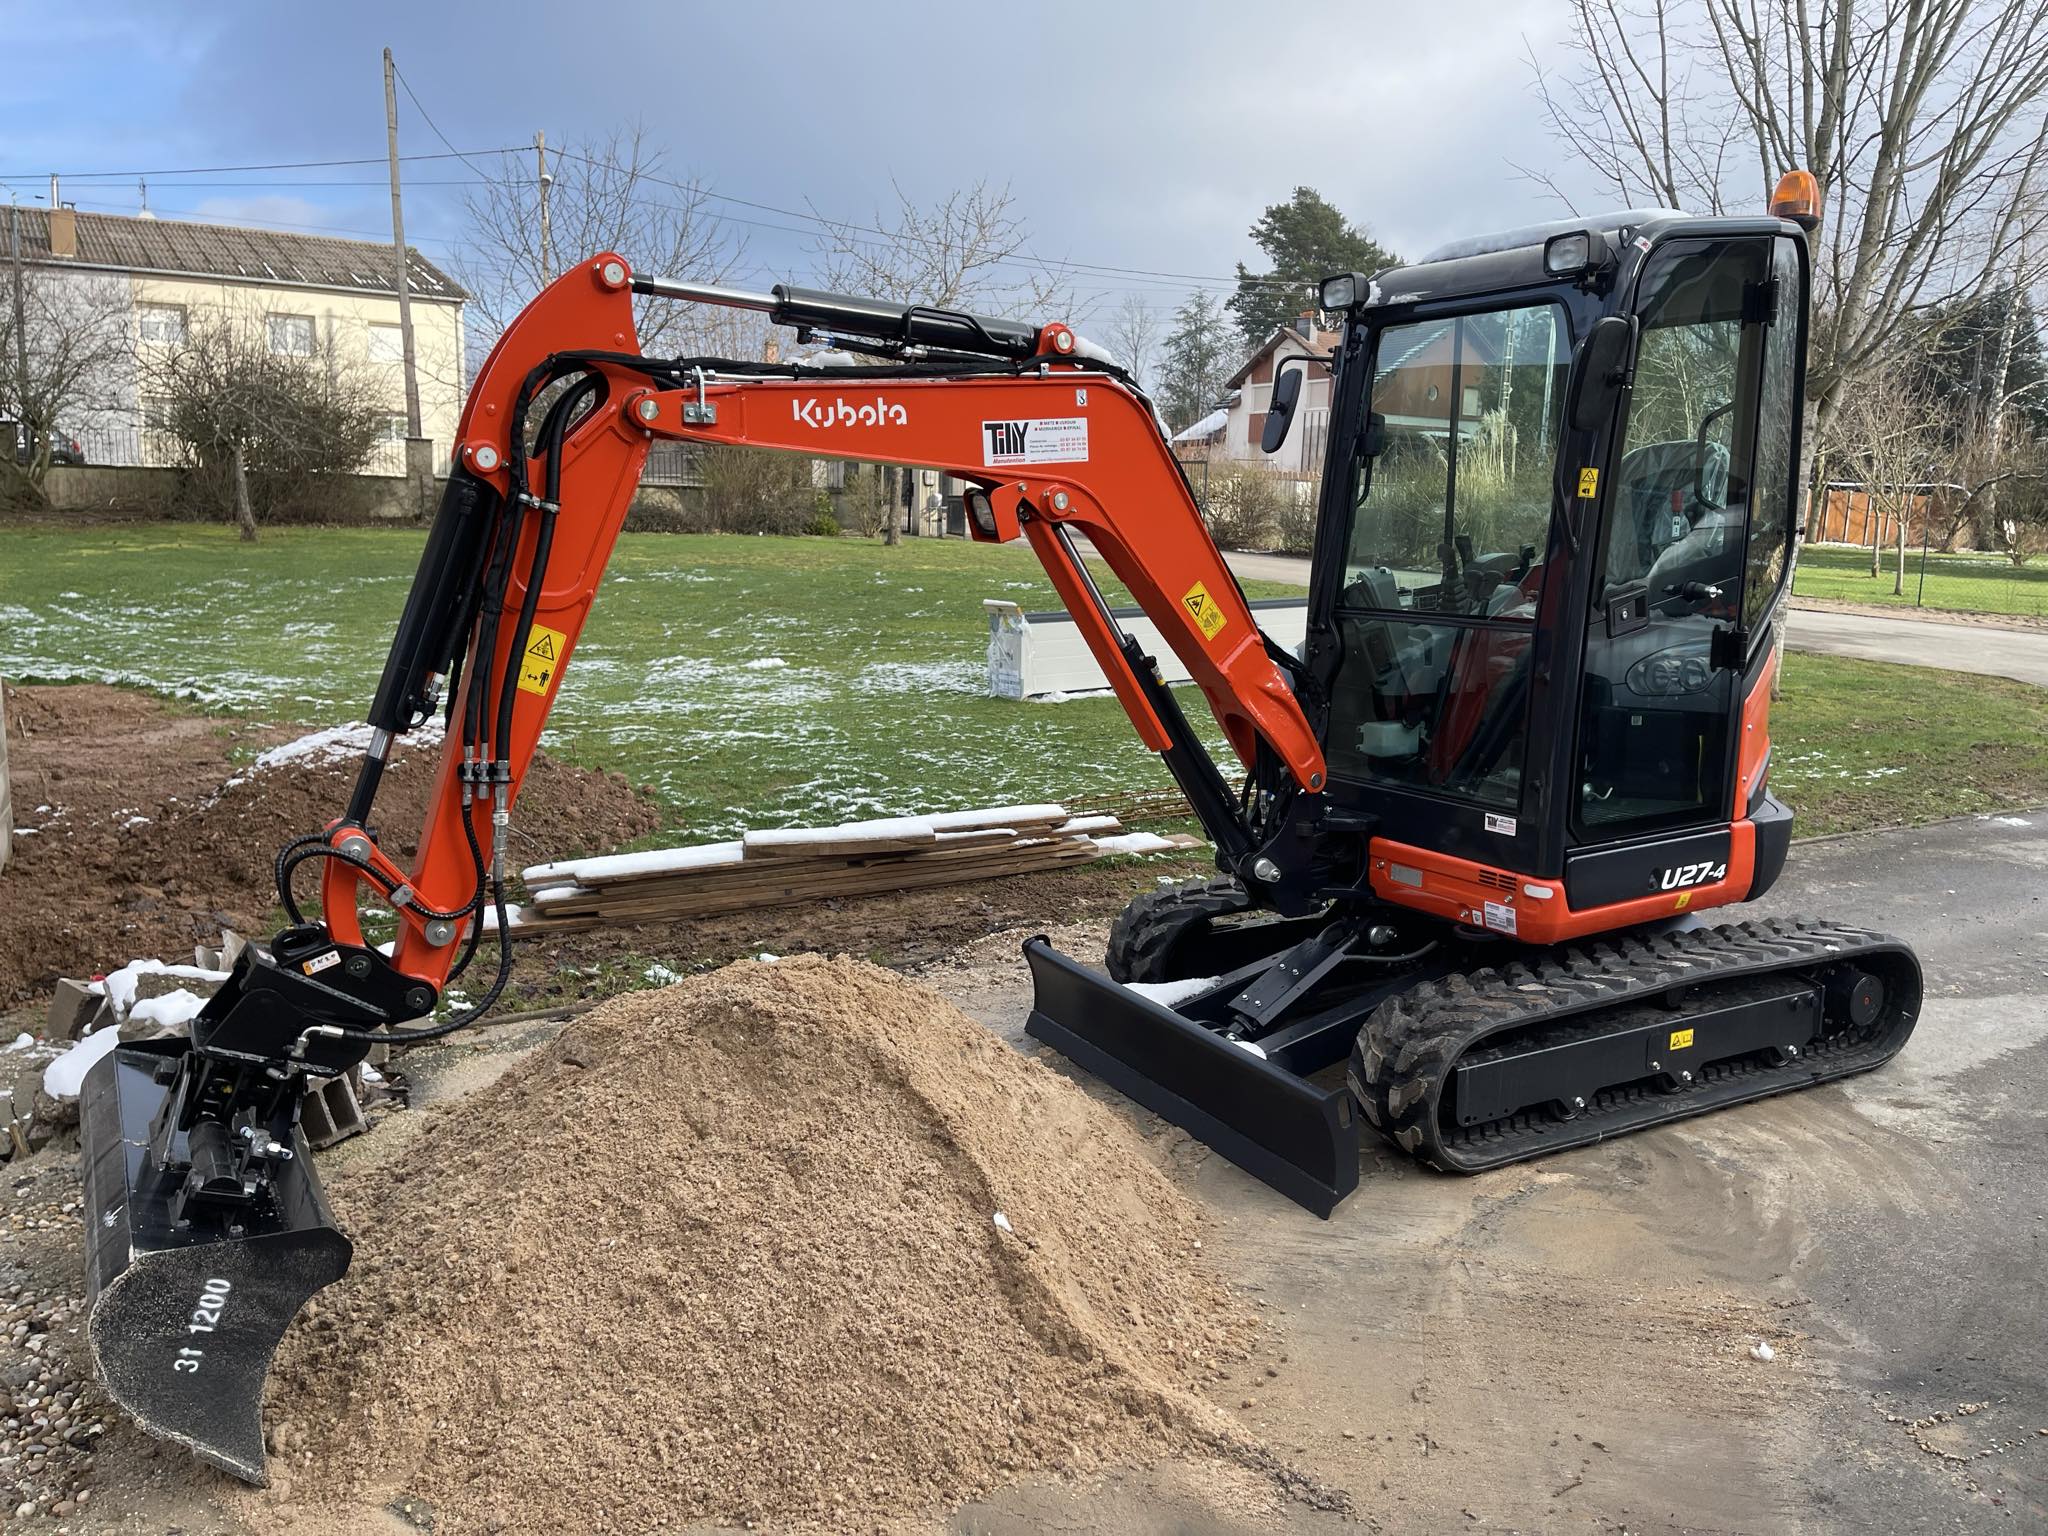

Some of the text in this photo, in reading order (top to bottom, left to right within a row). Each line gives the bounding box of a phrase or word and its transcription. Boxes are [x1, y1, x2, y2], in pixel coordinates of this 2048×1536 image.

[792, 397, 907, 428] Kubota
[1661, 861, 1727, 890] U27-4
[188, 1278, 231, 1334] 1200
